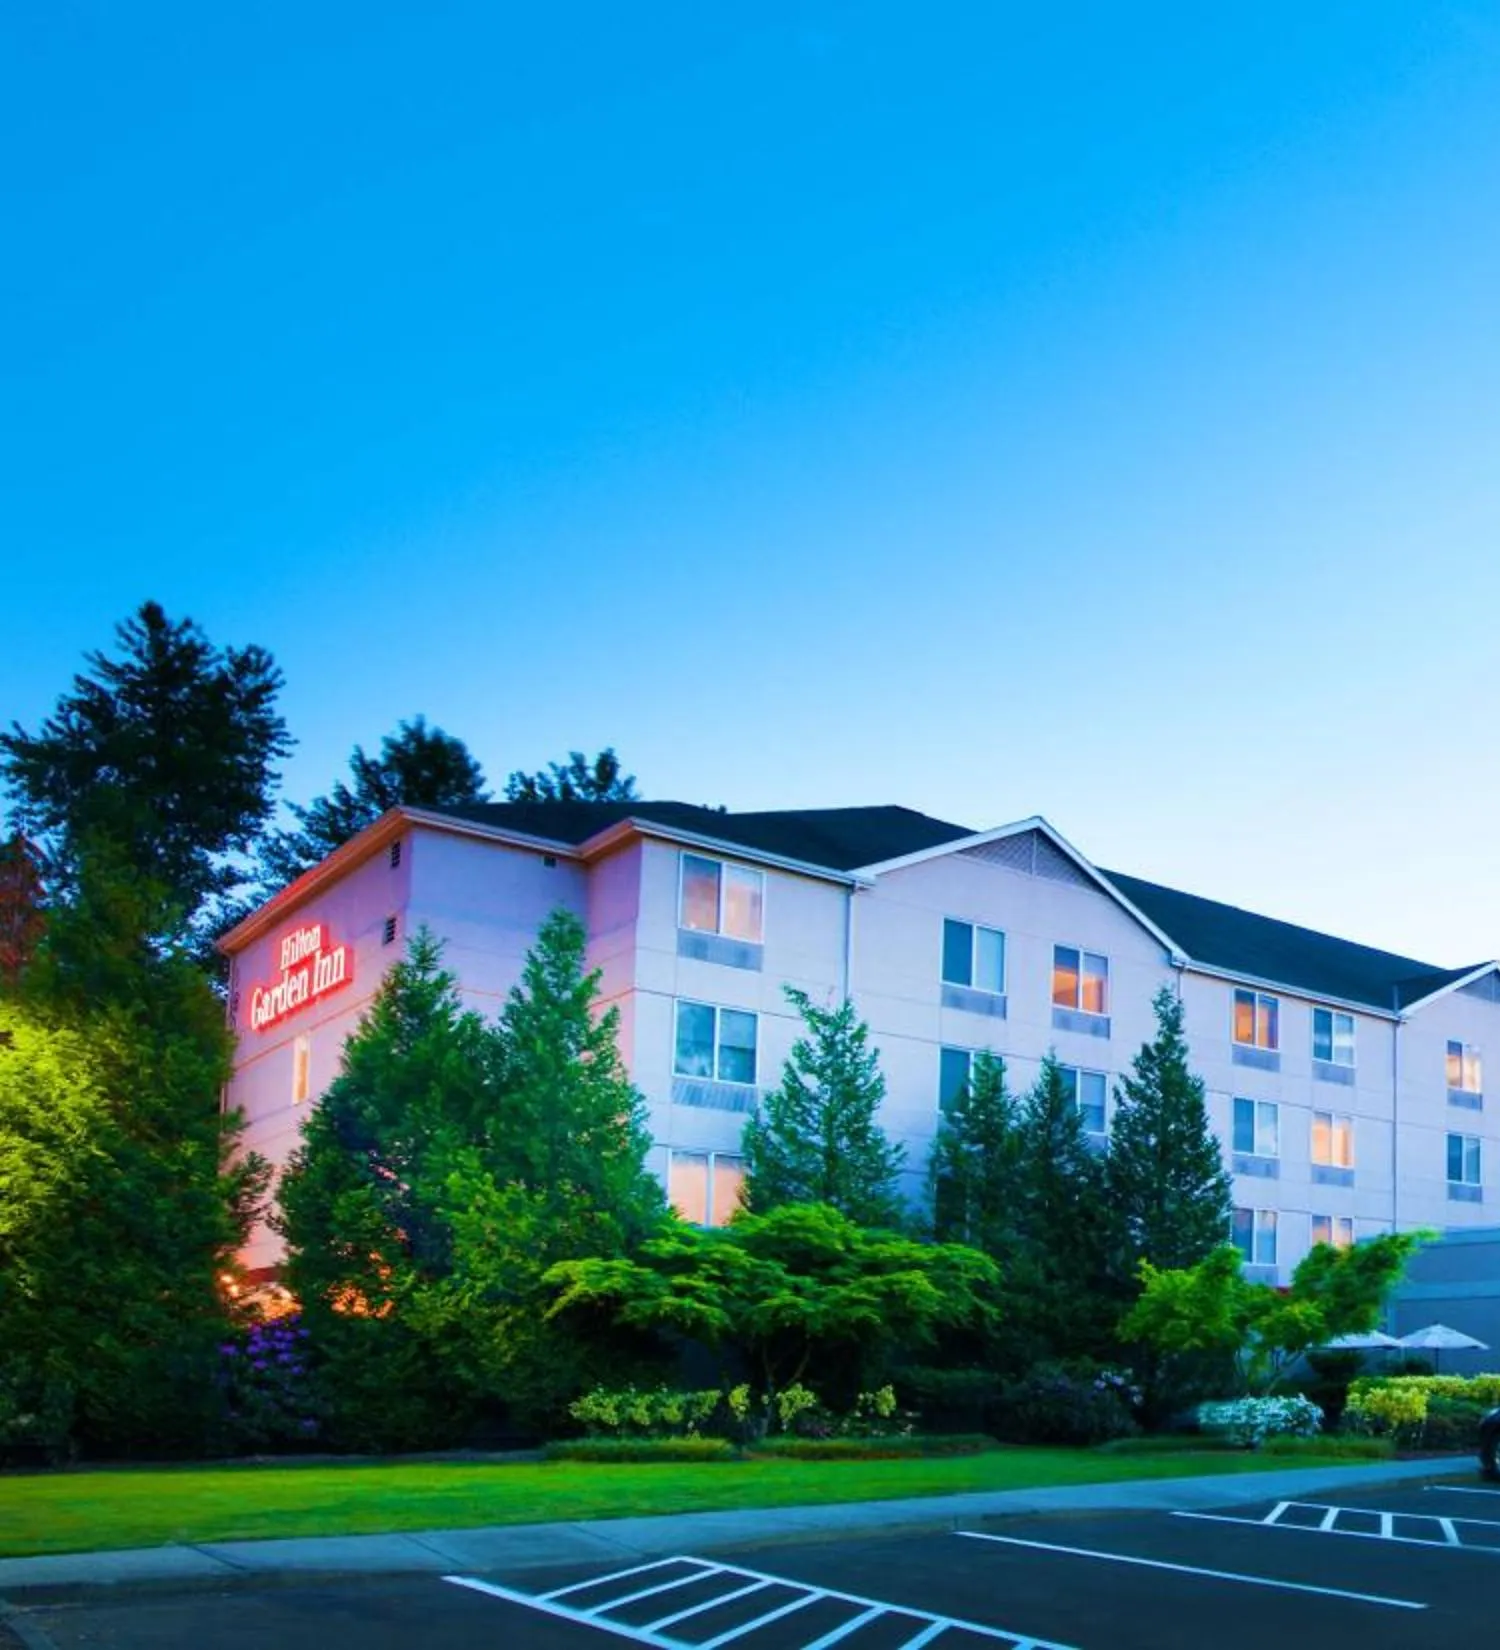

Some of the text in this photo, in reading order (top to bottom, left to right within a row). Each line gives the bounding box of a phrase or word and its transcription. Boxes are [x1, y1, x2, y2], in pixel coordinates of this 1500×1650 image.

[280, 924, 321, 971] Hilton
[251, 946, 345, 1031] Garden Inn
